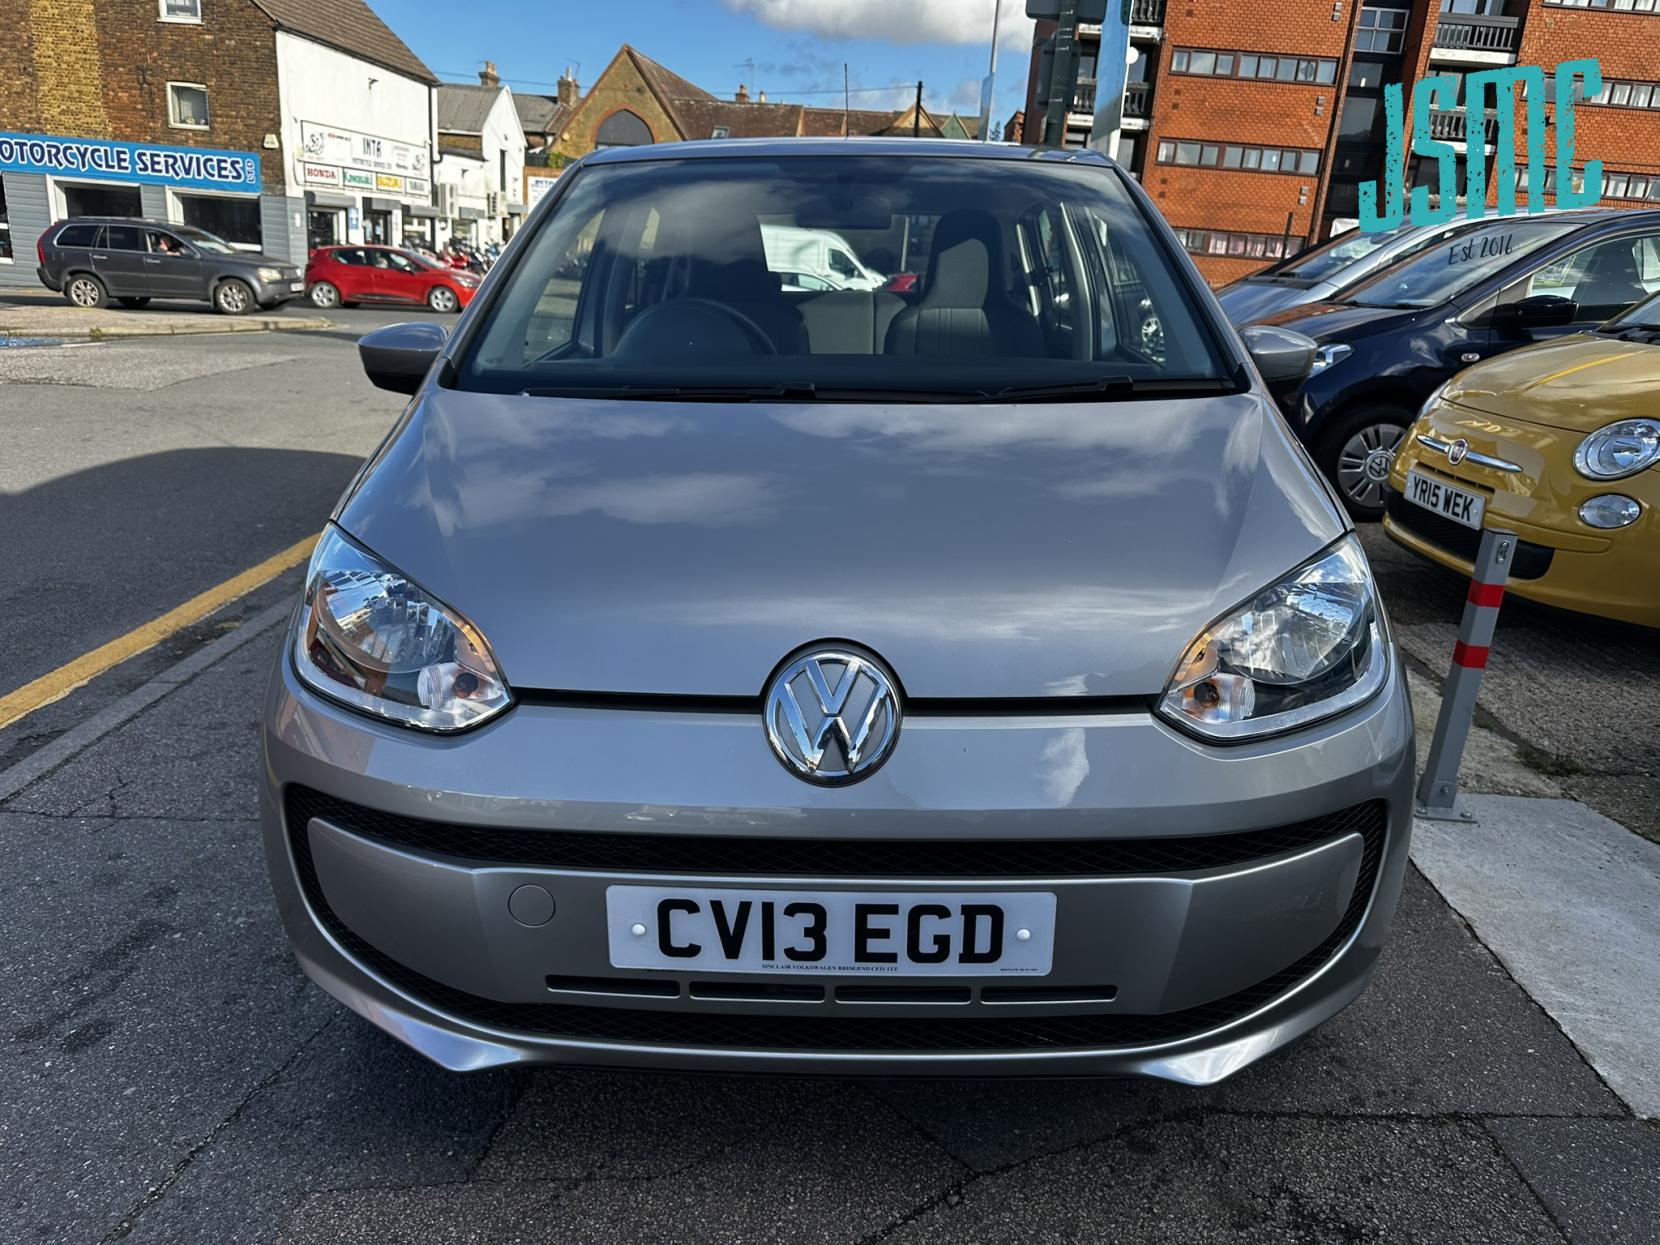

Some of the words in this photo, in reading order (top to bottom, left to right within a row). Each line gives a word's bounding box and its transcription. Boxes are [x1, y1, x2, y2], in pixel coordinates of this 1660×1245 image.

[0, 138, 130, 173] OTORCYCLE
[136, 151, 244, 182] SERVICES
[246, 158, 256, 184] LTD
[306, 168, 337, 179] HONDA
[1413, 475, 1441, 508] YR15
[1443, 488, 1474, 522] WEK
[656, 898, 828, 962] CV13
[854, 902, 1005, 964] EGD
